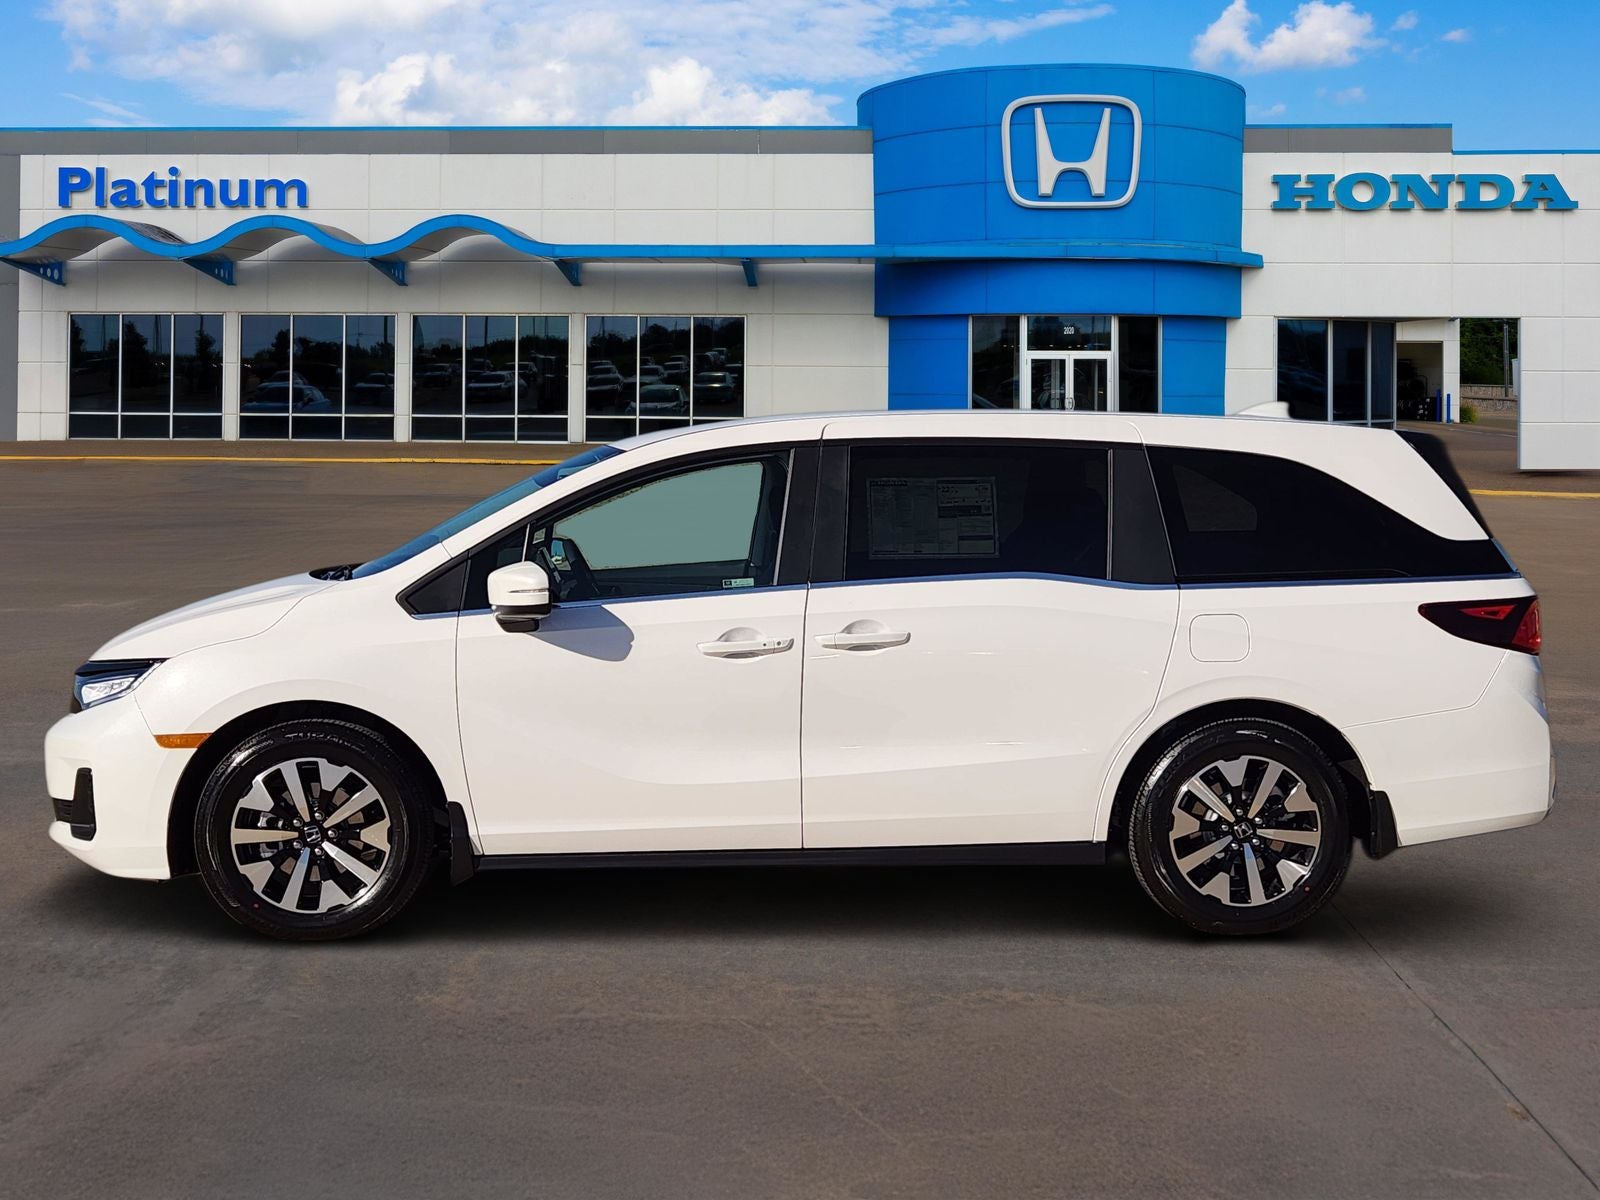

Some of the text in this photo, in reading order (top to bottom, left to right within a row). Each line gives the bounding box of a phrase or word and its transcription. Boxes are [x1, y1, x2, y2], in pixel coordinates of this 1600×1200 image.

[58, 166, 308, 208] Platinum
[1271, 173, 1579, 212] HONDA
[1063, 326, 1075, 335] 2020
